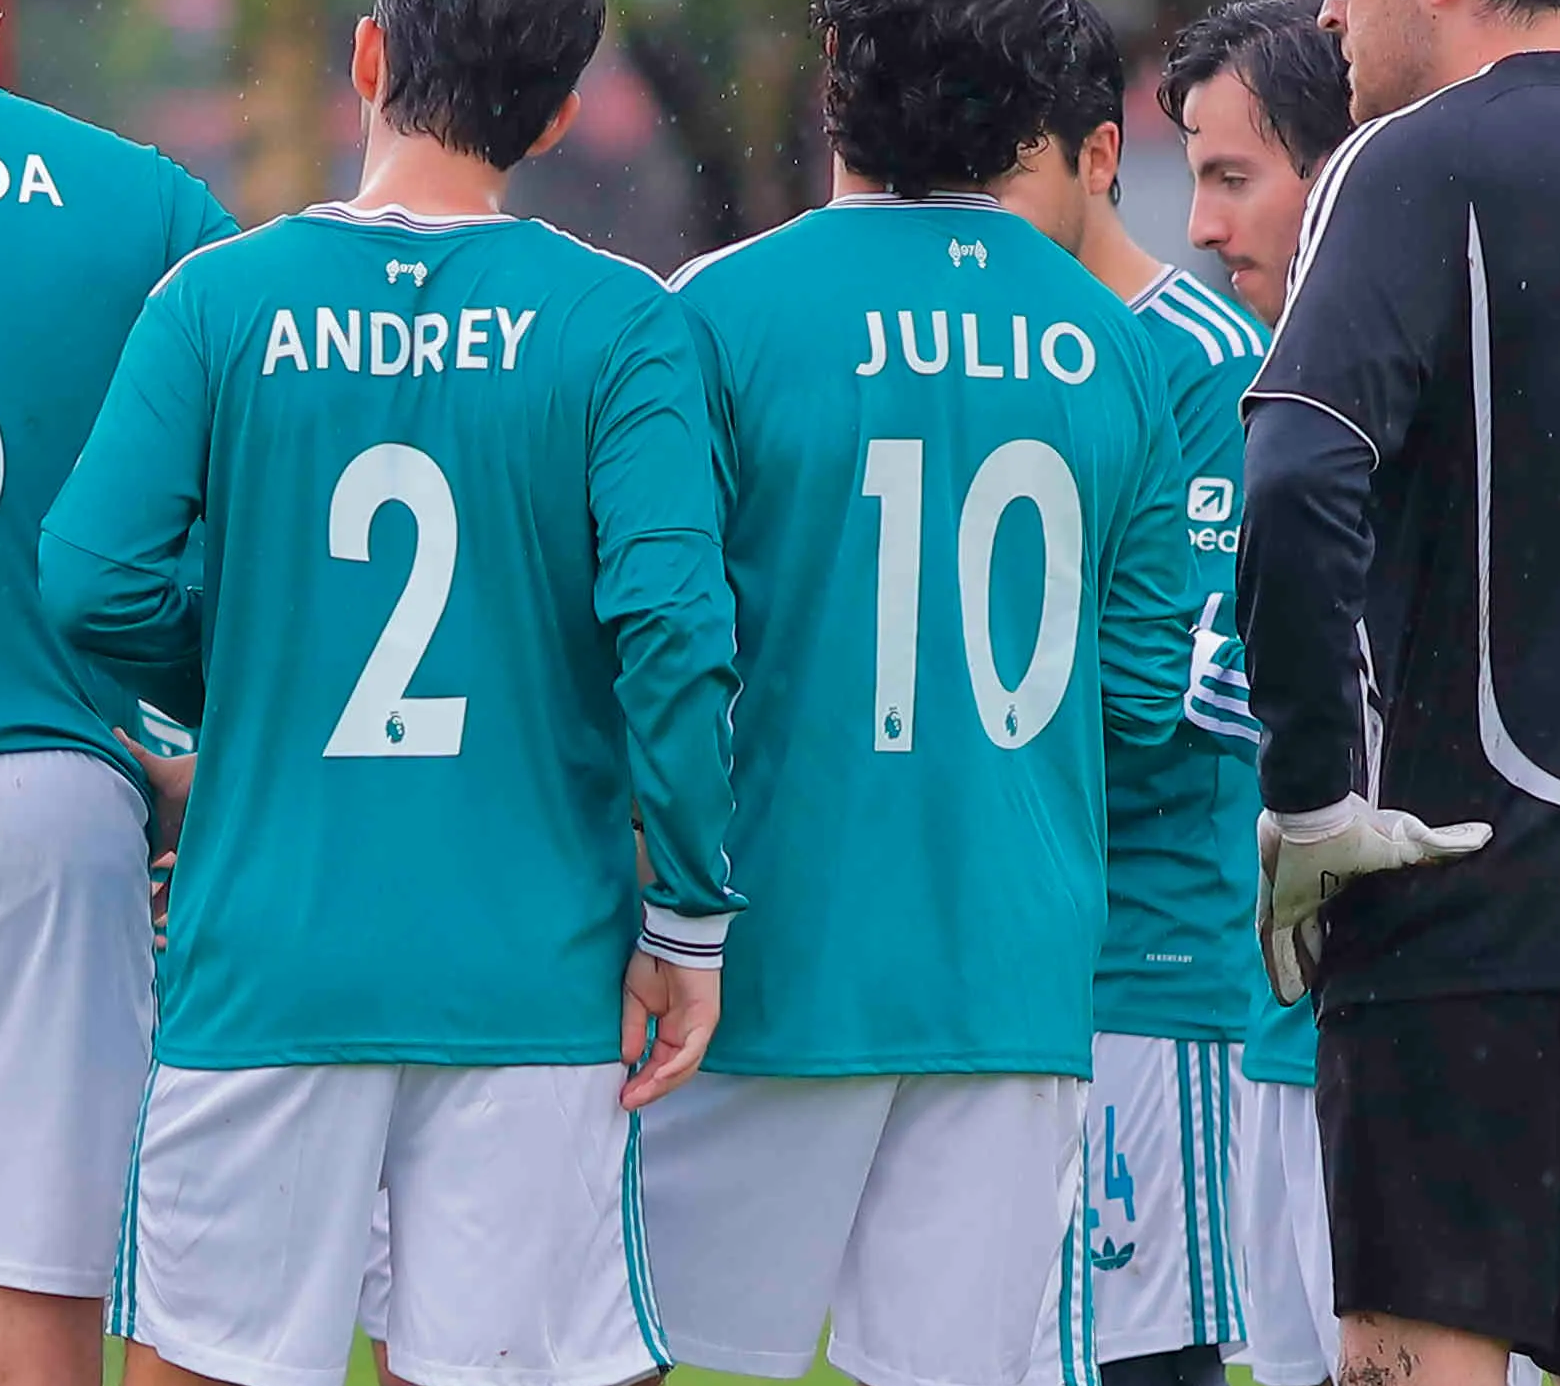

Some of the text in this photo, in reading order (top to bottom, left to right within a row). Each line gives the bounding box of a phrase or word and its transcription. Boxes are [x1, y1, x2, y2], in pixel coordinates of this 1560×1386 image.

[262, 307, 536, 377] ANDREY
[855, 310, 1096, 385] JULIO
[1188, 525, 1241, 553] ed
[323, 443, 467, 757] 2
[862, 439, 1083, 752] 10
